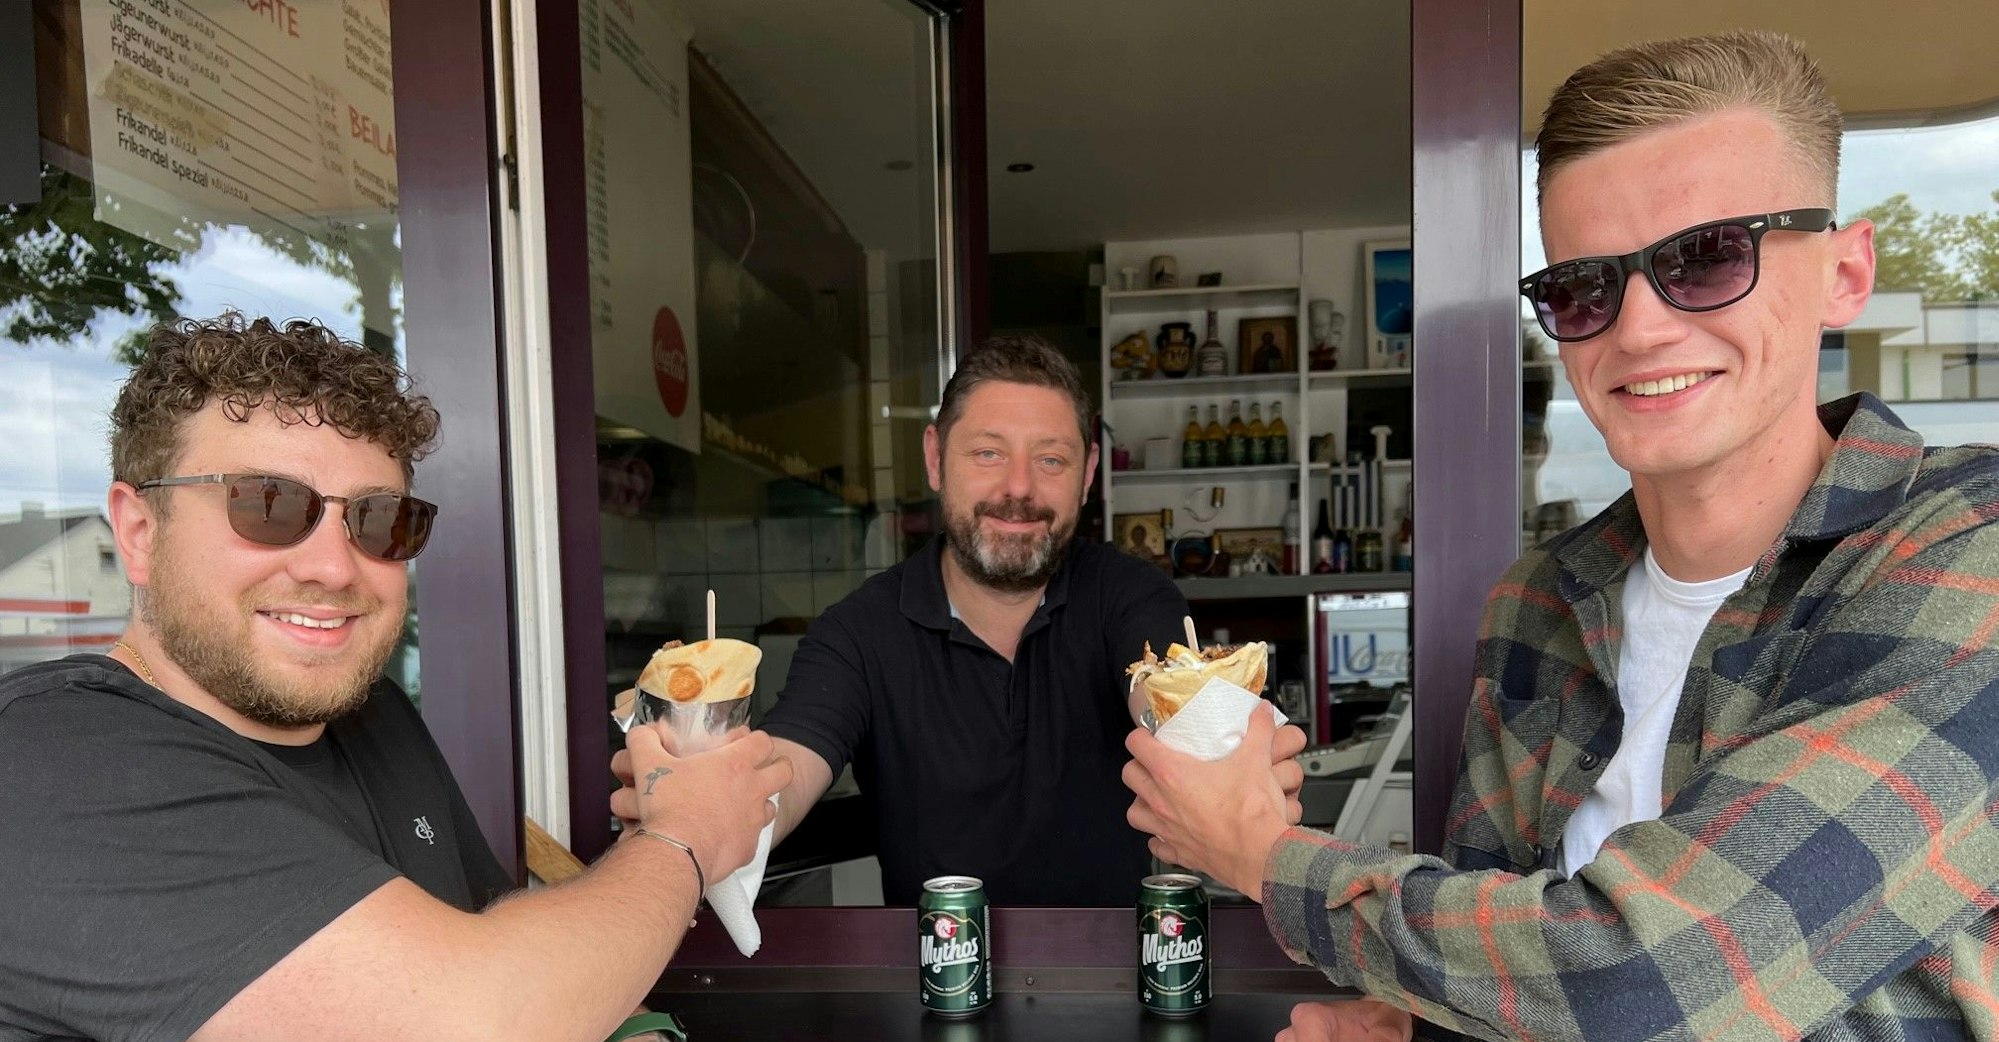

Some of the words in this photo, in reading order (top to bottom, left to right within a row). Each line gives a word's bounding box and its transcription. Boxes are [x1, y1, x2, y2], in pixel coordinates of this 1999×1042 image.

[109, 14, 175, 63] Jägerwurst
[111, 36, 163, 78] Frikadelle
[116, 107, 167, 145] Frikandel
[118, 131, 169, 169] Frikandel
[171, 160, 208, 188] spezial
[921, 935, 980, 974] Mythos
[1142, 933, 1204, 973] Mythos
